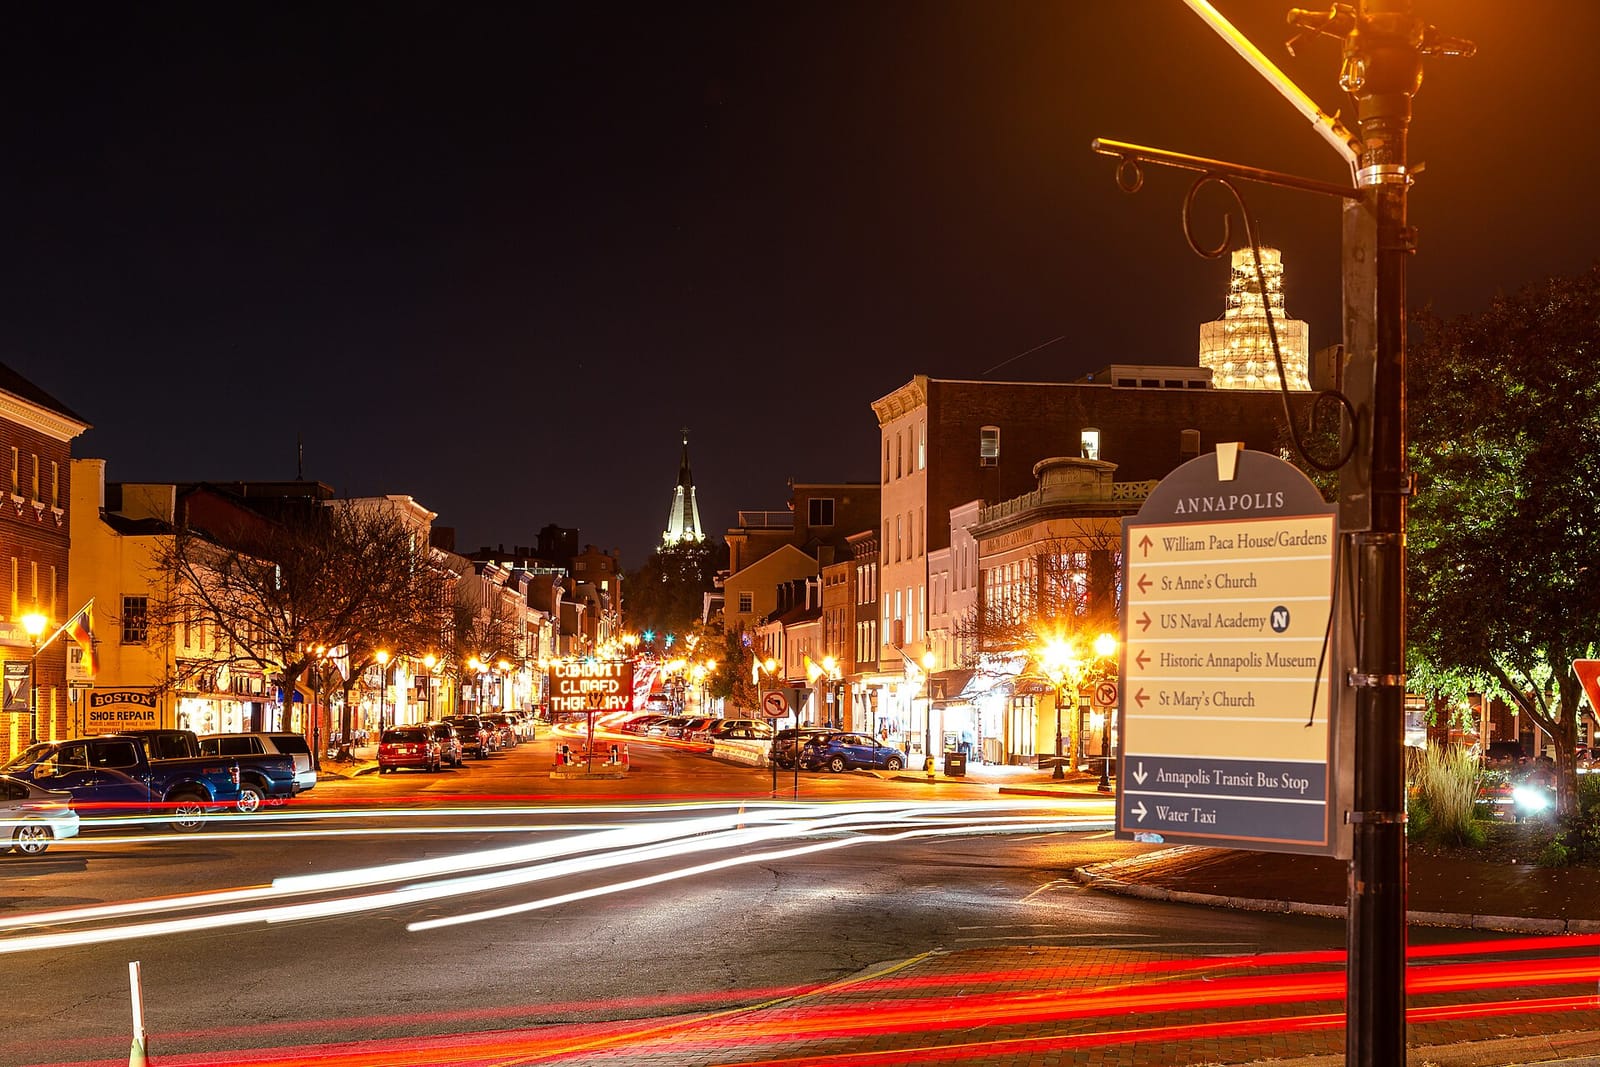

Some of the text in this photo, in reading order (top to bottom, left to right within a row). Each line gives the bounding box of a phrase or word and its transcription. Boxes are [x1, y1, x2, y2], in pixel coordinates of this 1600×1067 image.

[1174, 492, 1285, 514] ANNAPOLIS
[1162, 530, 1328, 552] William Paca House/Gardens
[1161, 571, 1257, 591] St Anne's Church
[1161, 611, 1288, 632] US Naval Academy N
[1160, 652, 1316, 672] Historic Annapolis Museum
[95, 693, 152, 706] BOSTON
[1158, 691, 1256, 710] St Mary's Church
[90, 711, 155, 721] SHOE REPAIR
[1156, 768, 1310, 793] Annapolis Transit Bus Stop
[1155, 805, 1217, 824] Water Taxi
